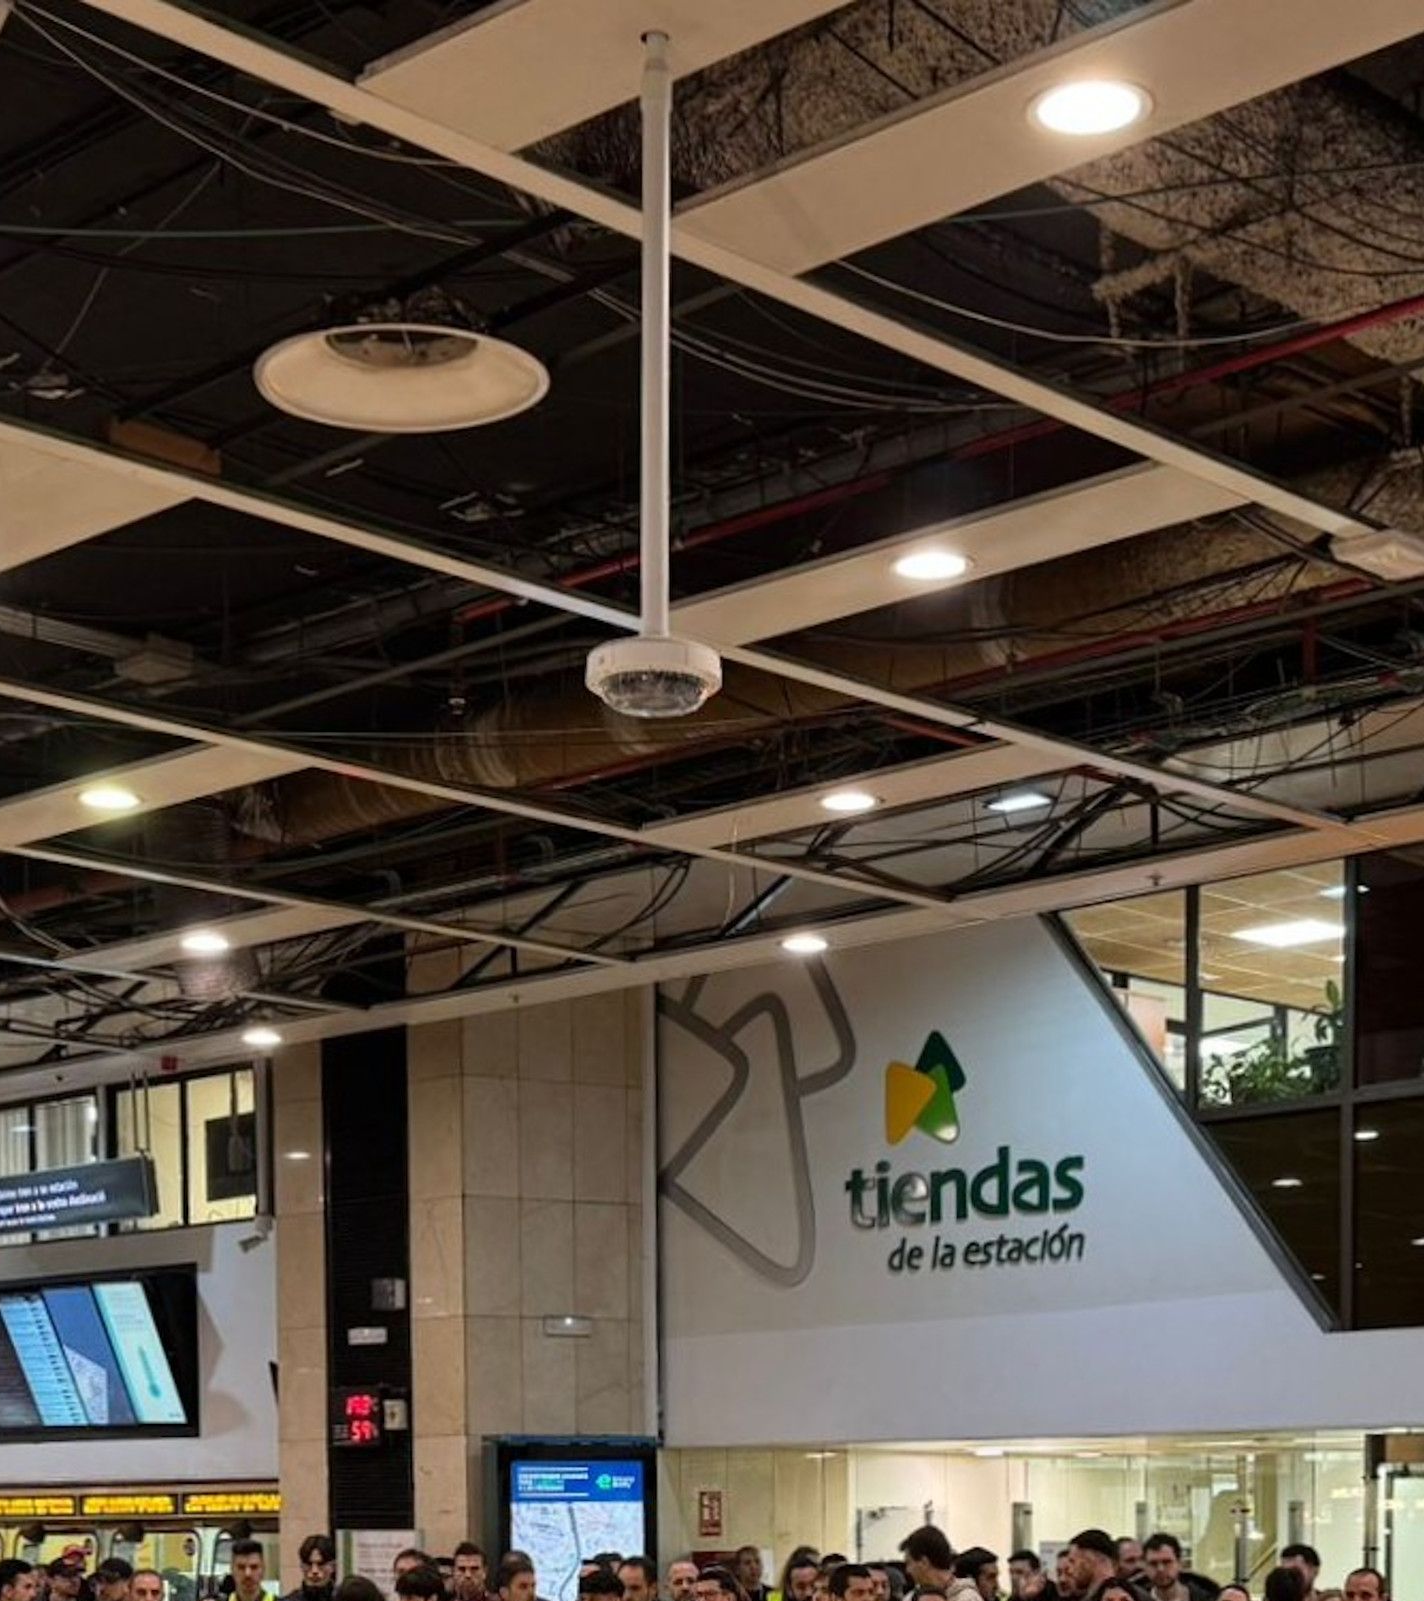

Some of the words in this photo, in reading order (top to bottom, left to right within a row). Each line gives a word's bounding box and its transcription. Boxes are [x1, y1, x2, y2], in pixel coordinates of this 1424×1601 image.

[845, 1146, 1085, 1229] tiendas
[888, 1237, 923, 1272] de
[931, 1236, 955, 1271] la
[962, 1223, 1086, 1267] estación
